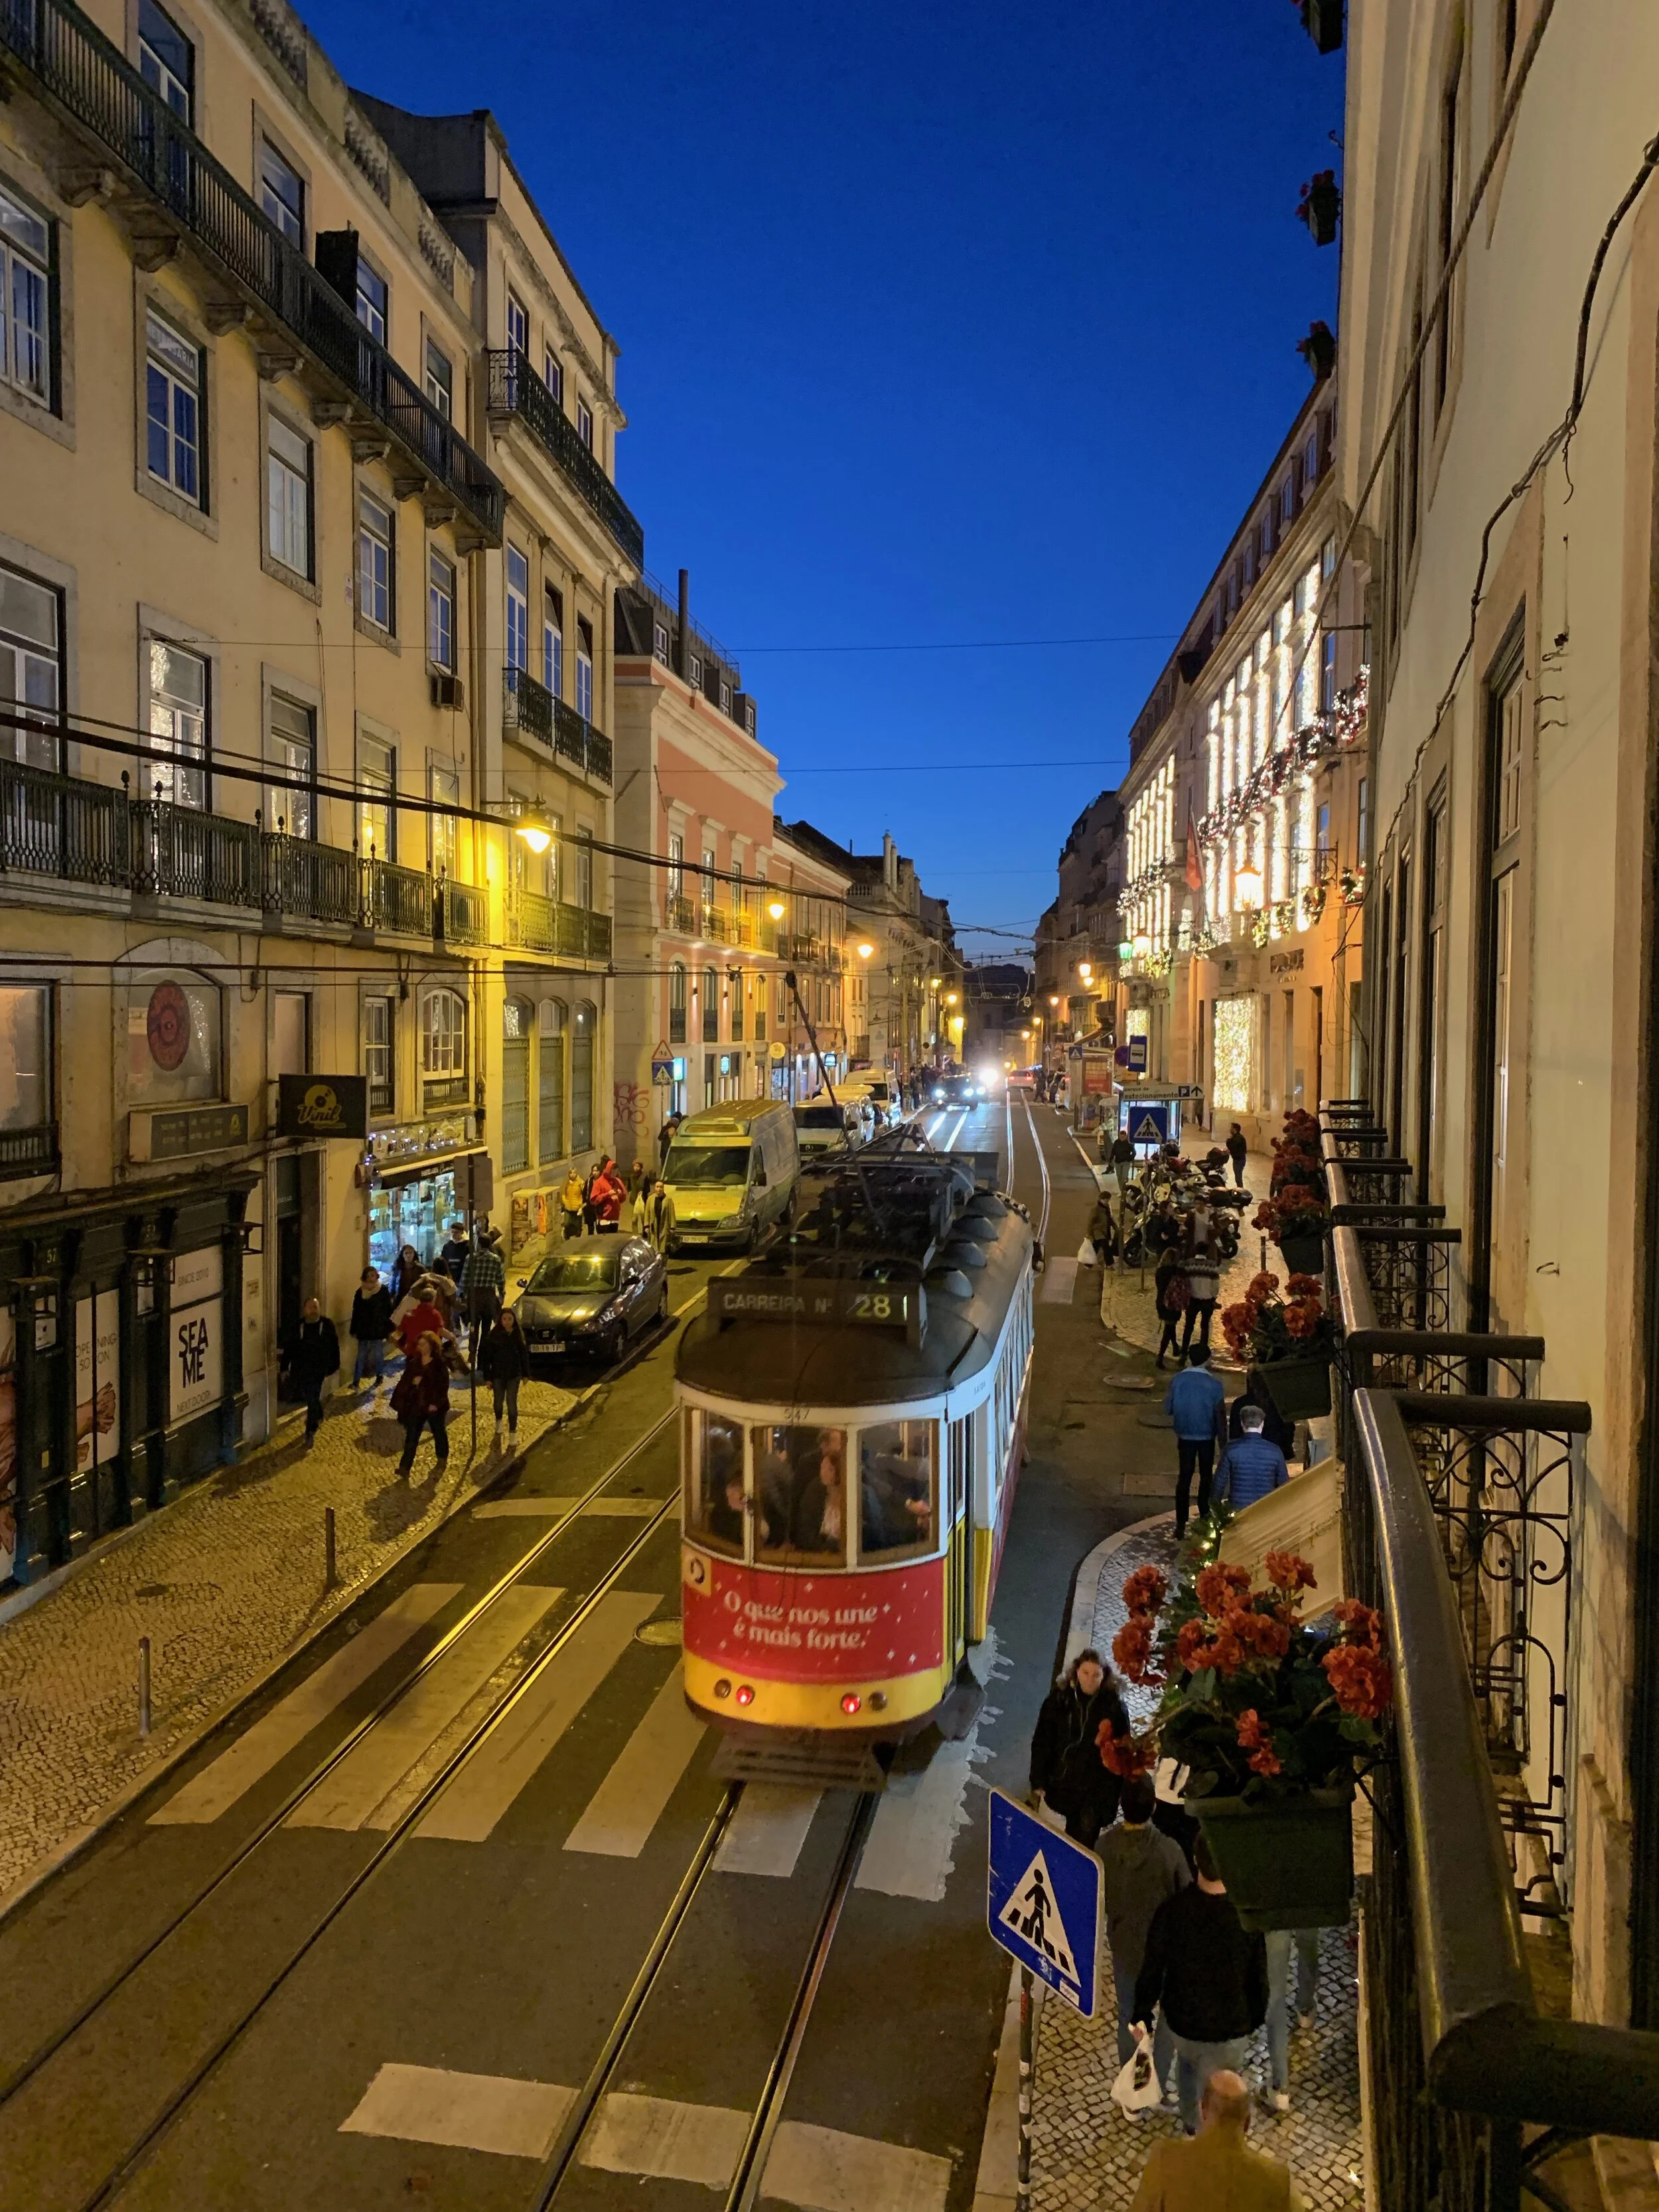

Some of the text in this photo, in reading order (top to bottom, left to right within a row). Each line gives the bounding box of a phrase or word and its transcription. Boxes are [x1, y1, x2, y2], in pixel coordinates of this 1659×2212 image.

[297, 1104, 342, 1124] Vinil
[178, 1268, 209, 1287] SINCE 2010
[723, 1293, 806, 1313] CARREIRA
[854, 1294, 891, 1319] 28
[178, 1317, 209, 1359] SEA
[182, 1347, 206, 1388] ME
[177, 1400, 192, 1414] NEXT
[723, 1590, 879, 1625] O que nos une
[749, 1625, 802, 1649] mais
